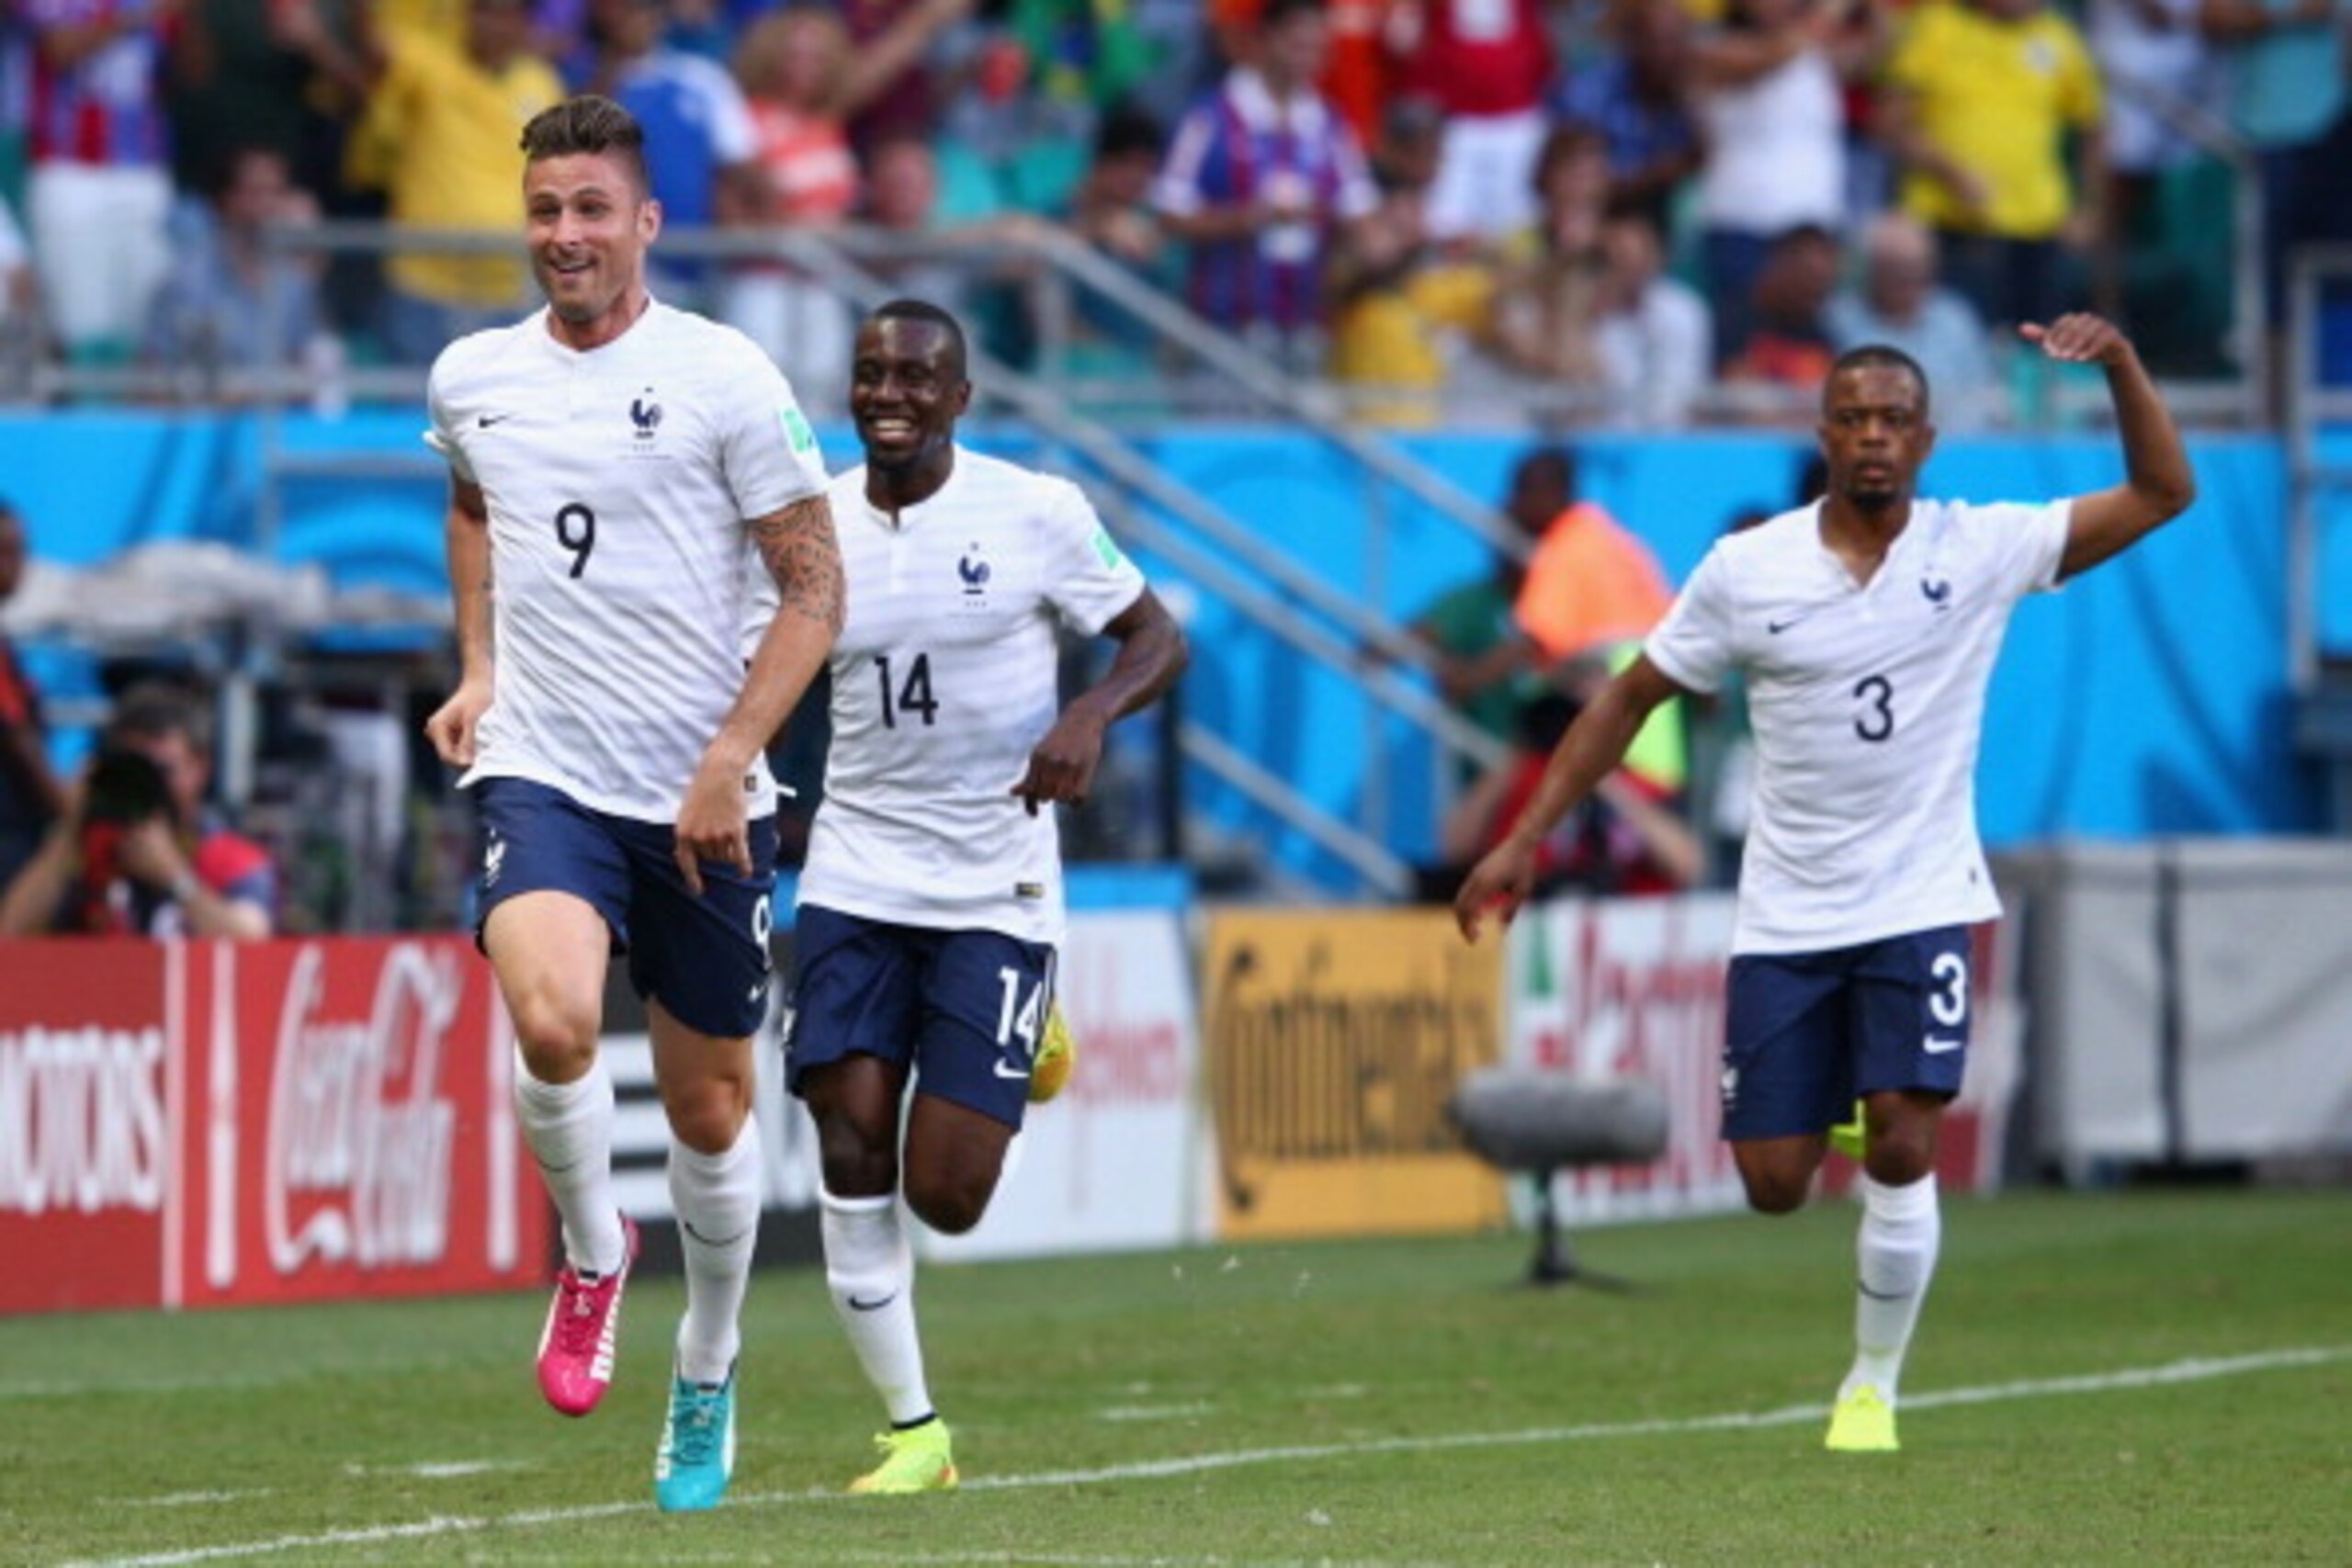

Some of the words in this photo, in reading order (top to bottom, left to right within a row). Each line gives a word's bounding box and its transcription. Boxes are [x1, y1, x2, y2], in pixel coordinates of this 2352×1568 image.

[556, 502, 595, 579] 9
[875, 653, 938, 728] 14
[1853, 675, 1894, 743] 3
[752, 894, 773, 971] 9
[997, 966, 1044, 1055] 14
[1929, 953, 1967, 1025] 3
